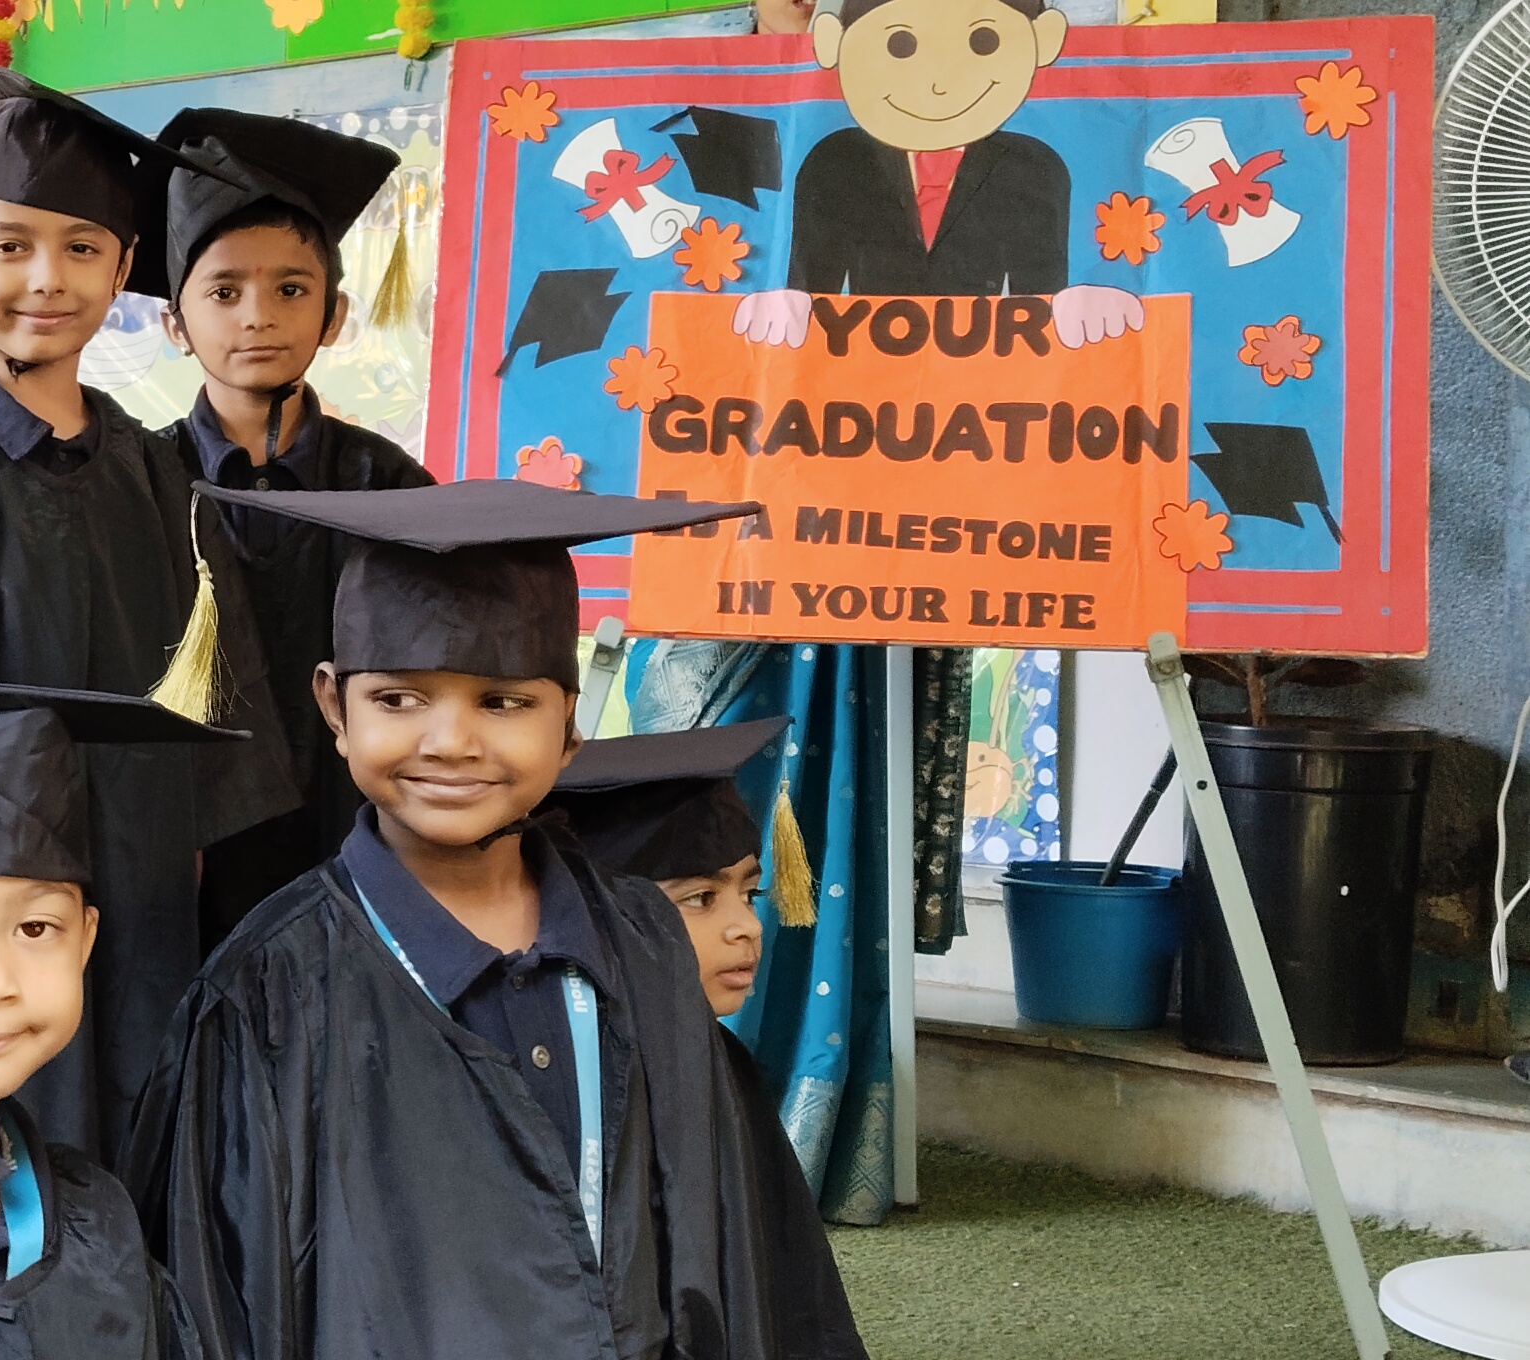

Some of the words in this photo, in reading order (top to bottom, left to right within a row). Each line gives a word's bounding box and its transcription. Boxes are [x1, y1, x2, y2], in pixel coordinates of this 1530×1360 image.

[811, 296, 1052, 358] YOUR
[648, 394, 1179, 464] GRADUATION
[794, 506, 1112, 563] MILESTONE
[716, 580, 775, 616] IN
[791, 582, 949, 625] YOUR
[968, 589, 1097, 630] LIFE
